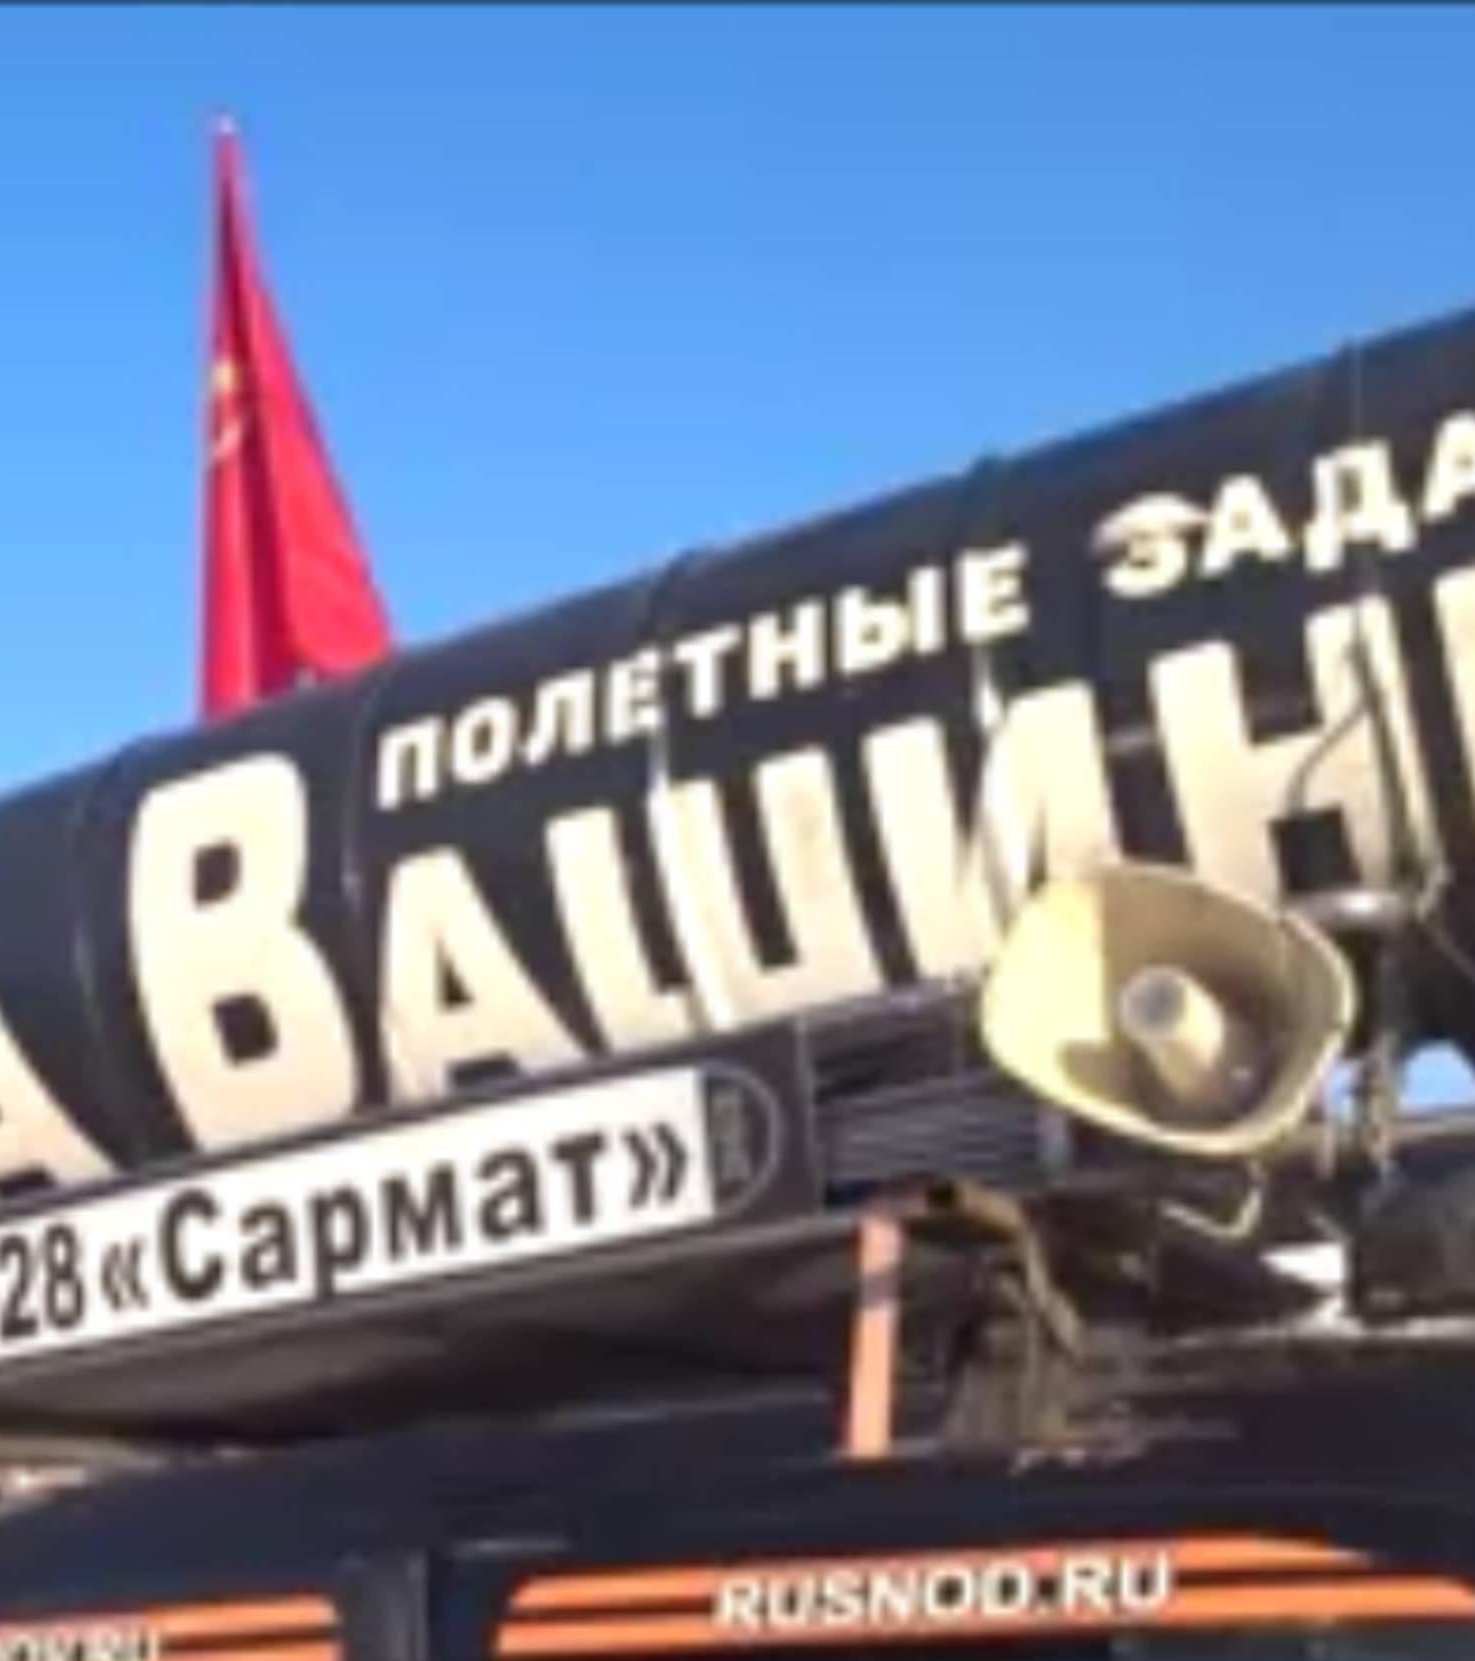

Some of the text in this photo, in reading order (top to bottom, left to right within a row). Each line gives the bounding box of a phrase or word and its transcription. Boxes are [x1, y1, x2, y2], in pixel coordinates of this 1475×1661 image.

[377, 543, 1031, 808] ПОЛЕТНЫЕ
[100, 1122, 691, 1312] «Сармат»
[714, 1551, 1171, 1629] RUSNOD.RU
